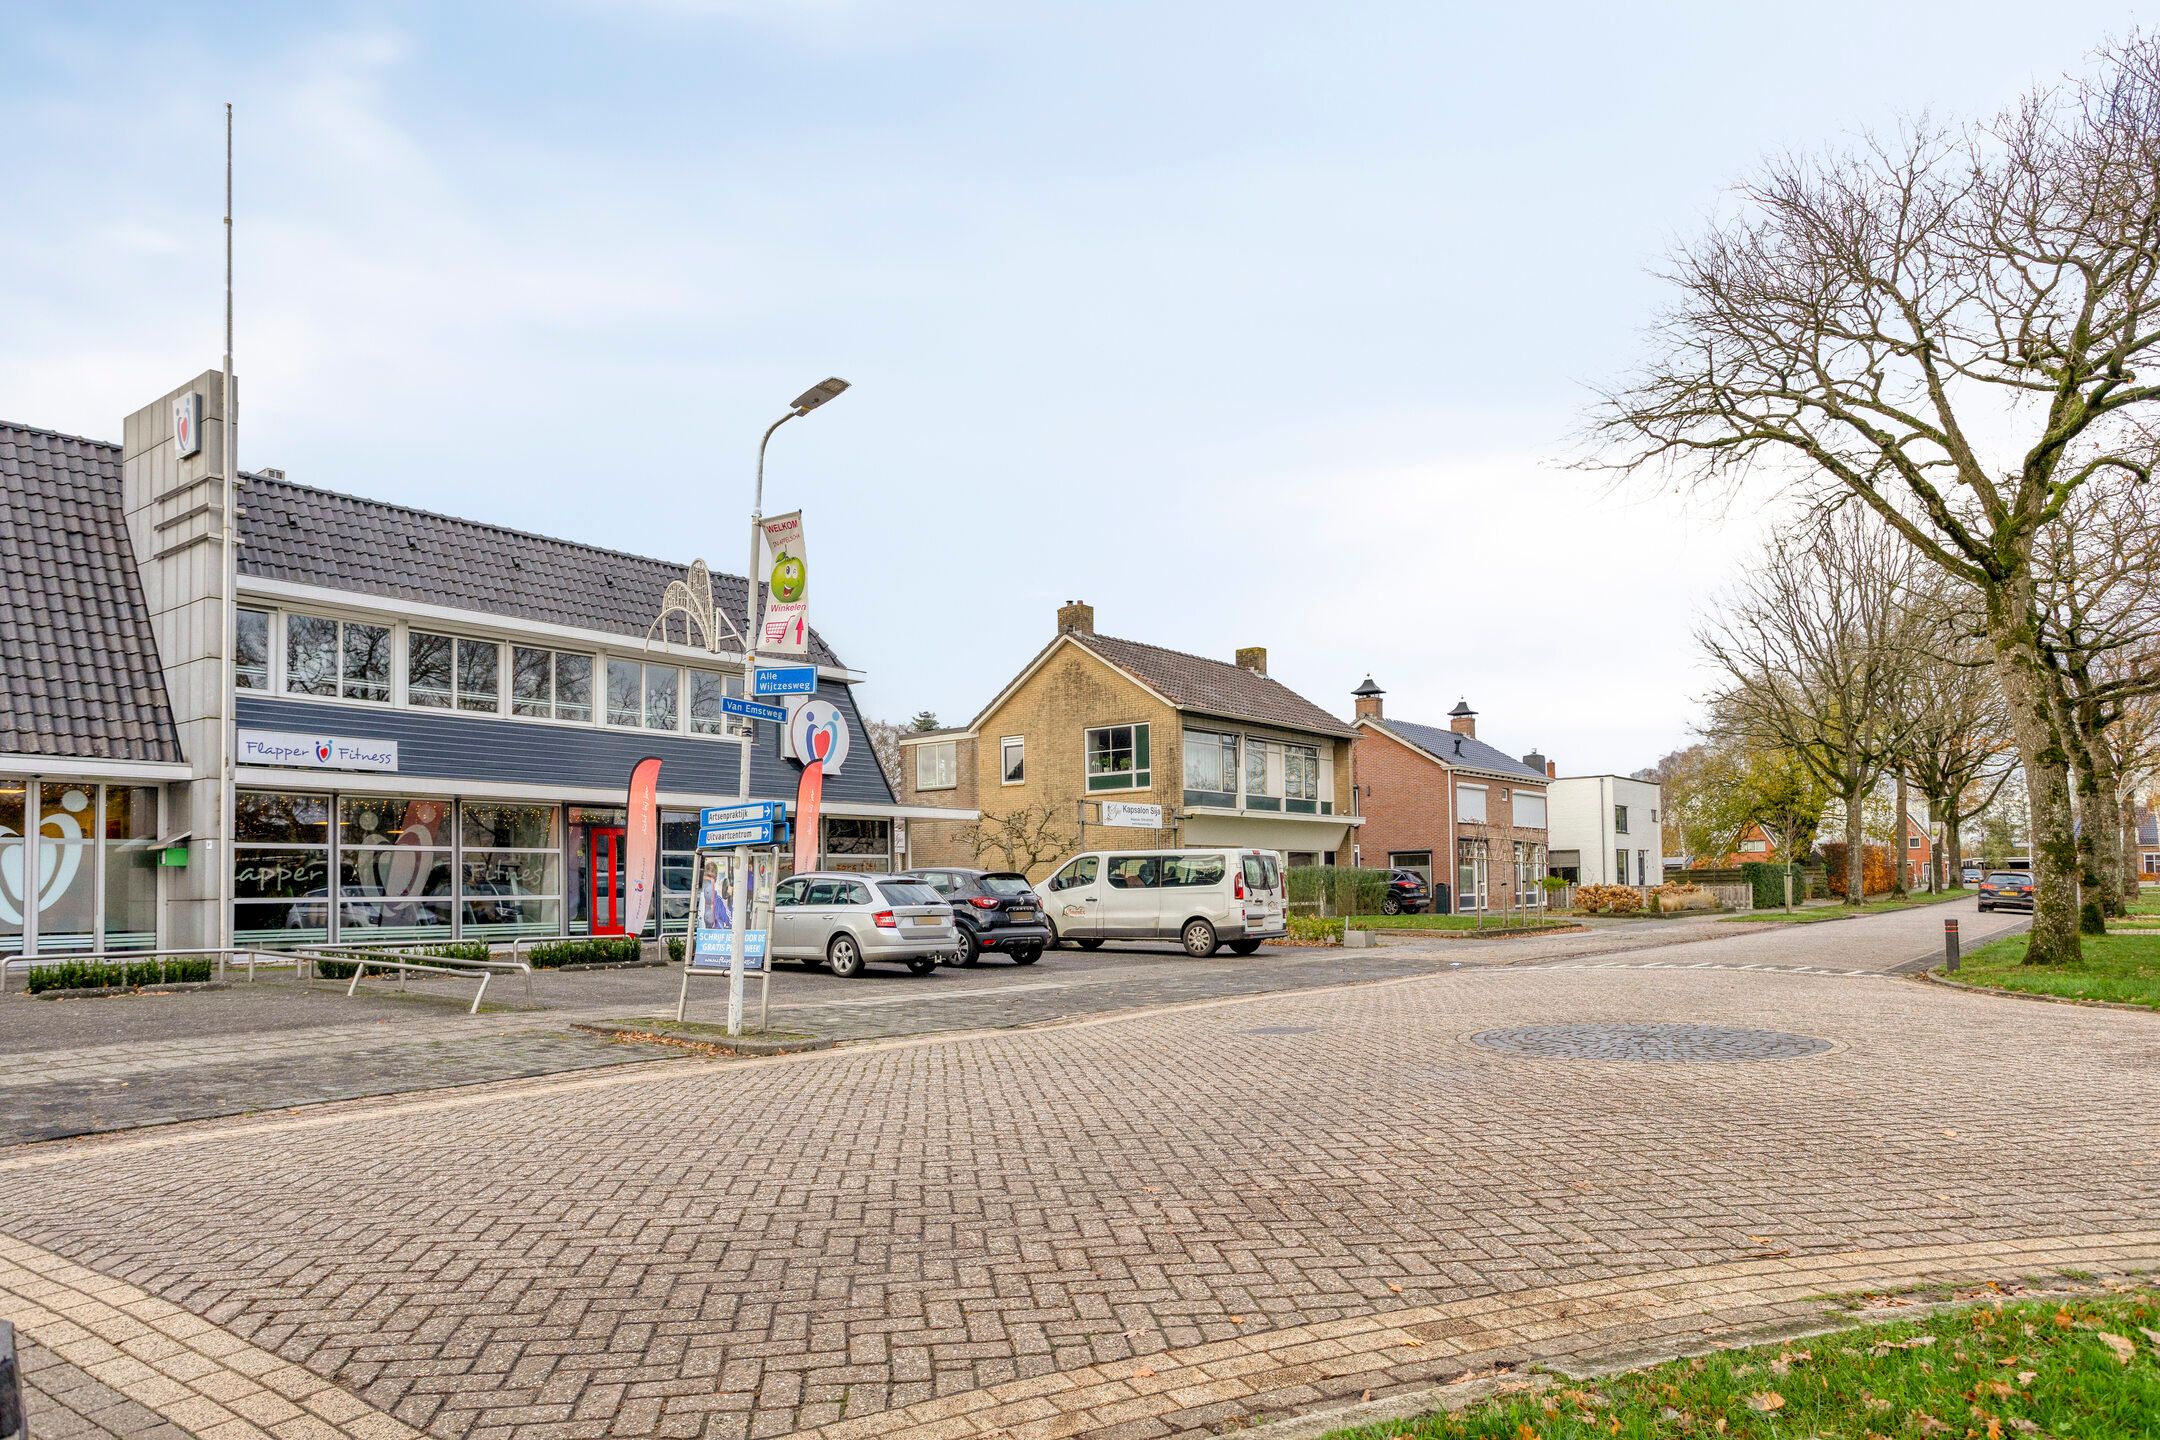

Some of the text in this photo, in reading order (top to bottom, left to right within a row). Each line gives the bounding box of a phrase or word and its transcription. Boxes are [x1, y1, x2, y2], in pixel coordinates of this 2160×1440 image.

[767, 520, 798, 534] WELKOM
[771, 603, 807, 612] Winkelen
[760, 672, 777, 680] Alle
[760, 682, 810, 692] Wijtzesweg
[727, 701, 783, 720] Van Emstweg
[245, 741, 392, 765] Flapper Fitness
[709, 809, 748, 821] Artsenpraktijk
[1122, 805, 1149, 815] Kapsalon
[707, 830, 752, 841] Uitvaartcentrum
[235, 867, 324, 891] apper
[700, 933, 725, 943] SCHRIJF
[703, 943, 725, 952] GRATIS
